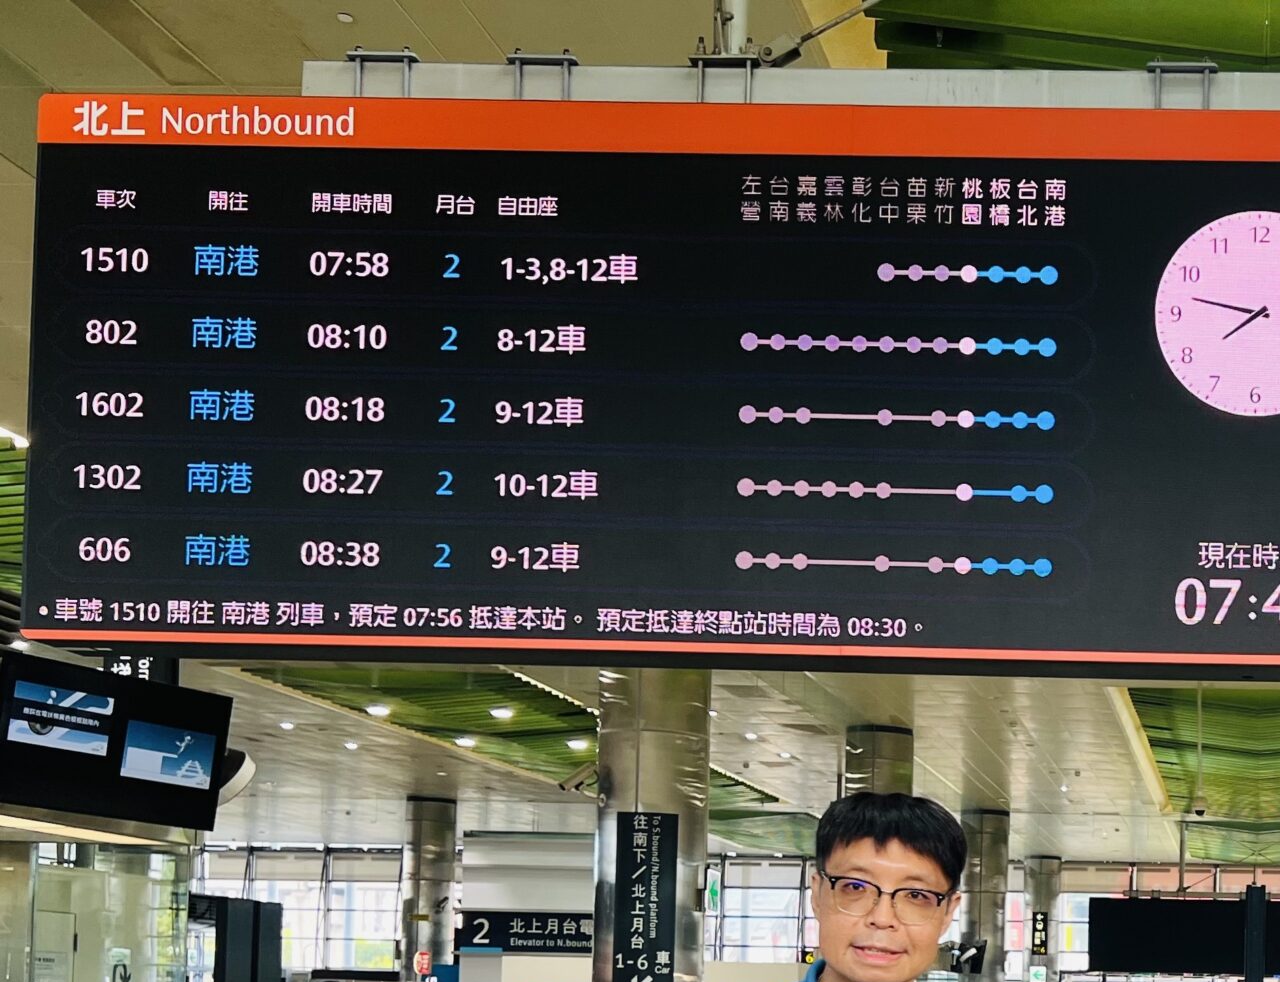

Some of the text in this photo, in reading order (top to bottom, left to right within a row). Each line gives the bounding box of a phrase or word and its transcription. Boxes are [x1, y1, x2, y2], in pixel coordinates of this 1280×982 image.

[73, 101, 354, 136] 北上 Northbound
[96, 189, 558, 216] 車次 開往 開車時間 月台 自由座
[1213, 238, 1227, 253] 11
[1253, 227, 1270, 243] 12
[81, 244, 638, 284] 1510 南港 07:58 2 1-3,8-12車
[1183, 266, 1200, 282] 10
[1171, 306, 1181, 321] 9
[86, 316, 586, 355] 802 南港 08:10 2 8-12車
[1182, 347, 1192, 363] 8
[1210, 376, 1220, 391] 7
[1250, 387, 1260, 403] 6
[76, 389, 583, 427] 1602 南港 08:18 2 9-12車
[74, 462, 598, 500] 1302 南港 08:27 2 10-12車
[79, 534, 579, 572] 606 南港 08:38 2 9-12車
[54, 598, 102, 621] 車號
[110, 603, 160, 621] 1510
[167, 601, 214, 624] 開往
[222, 601, 269, 625] 南港
[404, 608, 462, 627] 07:56
[597, 609, 840, 637] 預定抵達終點站時間為
[652, 816, 661, 826] To
[472, 918, 490, 943] 2
[648, 903, 658, 938] platform
[510, 937, 544, 946] Elevator
[546, 938, 554, 946] to
[616, 951, 671, 973] 1-6 車 Car
